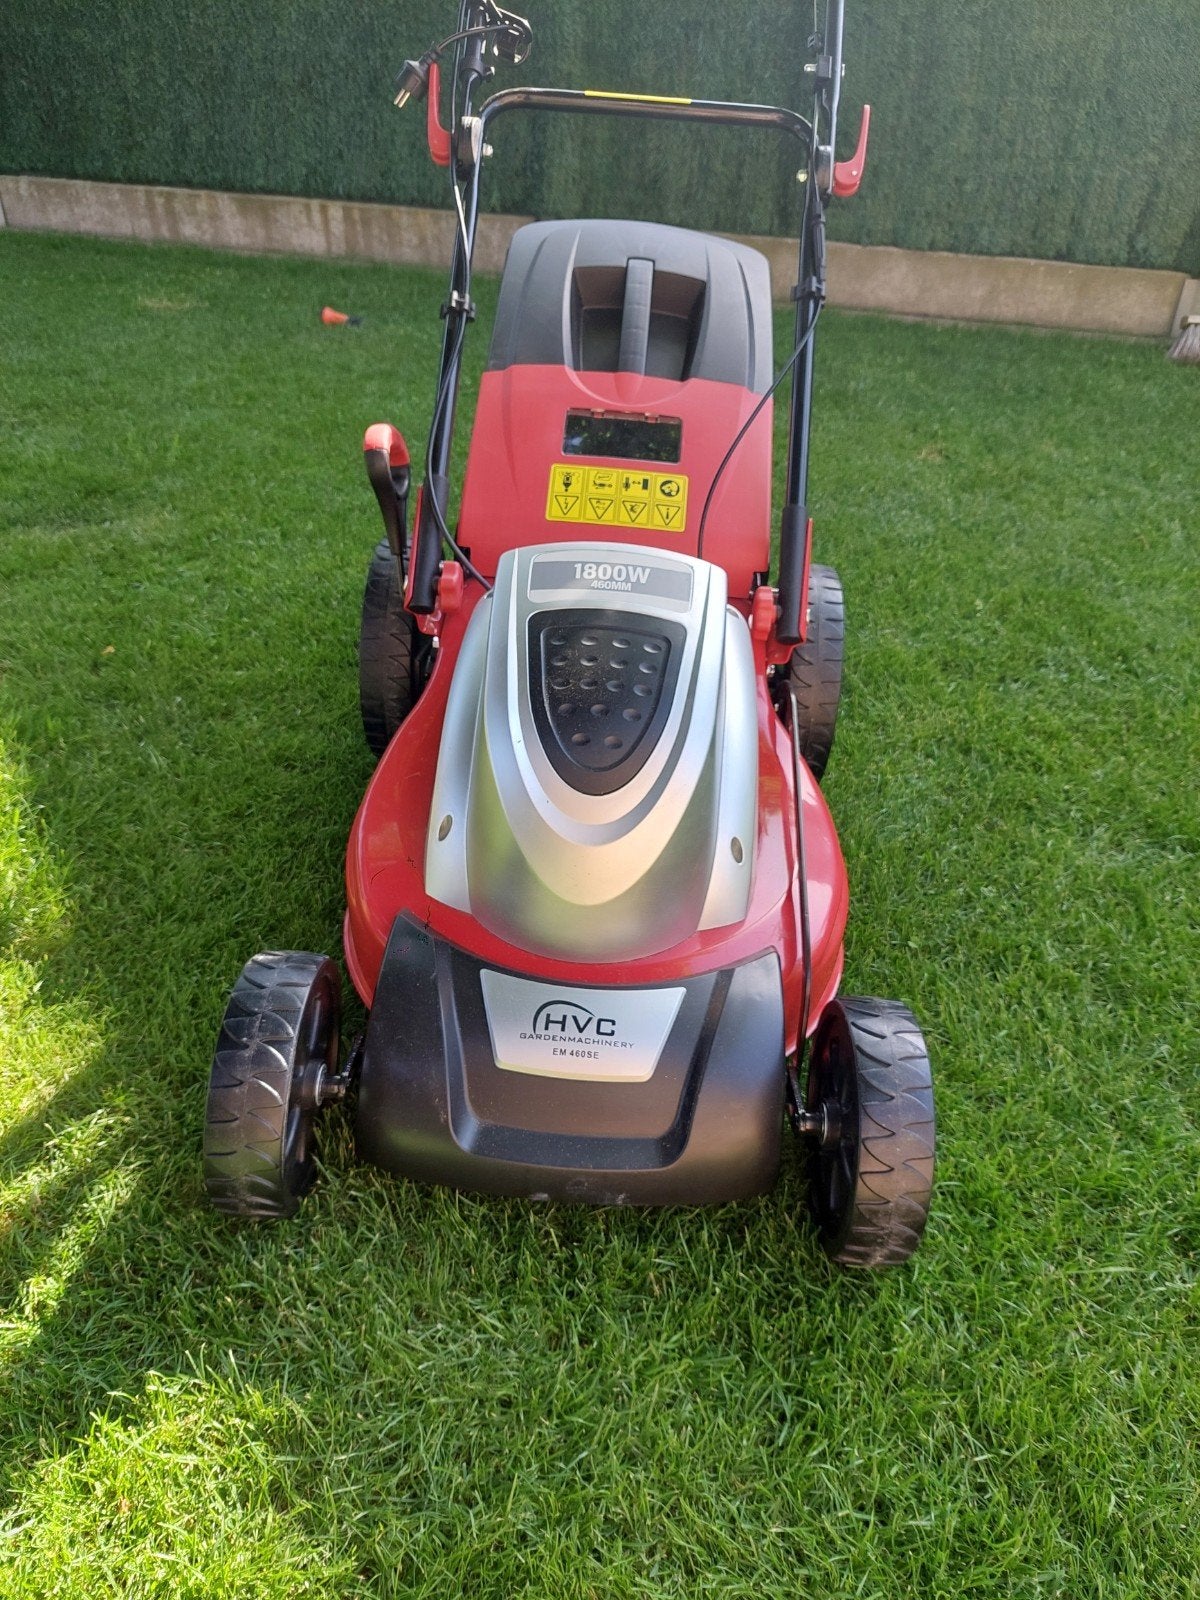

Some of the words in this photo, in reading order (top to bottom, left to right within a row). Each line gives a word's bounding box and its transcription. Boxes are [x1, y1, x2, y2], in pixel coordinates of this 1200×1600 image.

[574, 563, 651, 584] 1800W
[590, 580, 632, 592] 460MM
[544, 1013, 616, 1036] HVC
[519, 1032, 635, 1049] GARDENMACHINERY
[552, 1048, 567, 1056] EM
[569, 1049, 600, 1059] 460SE
